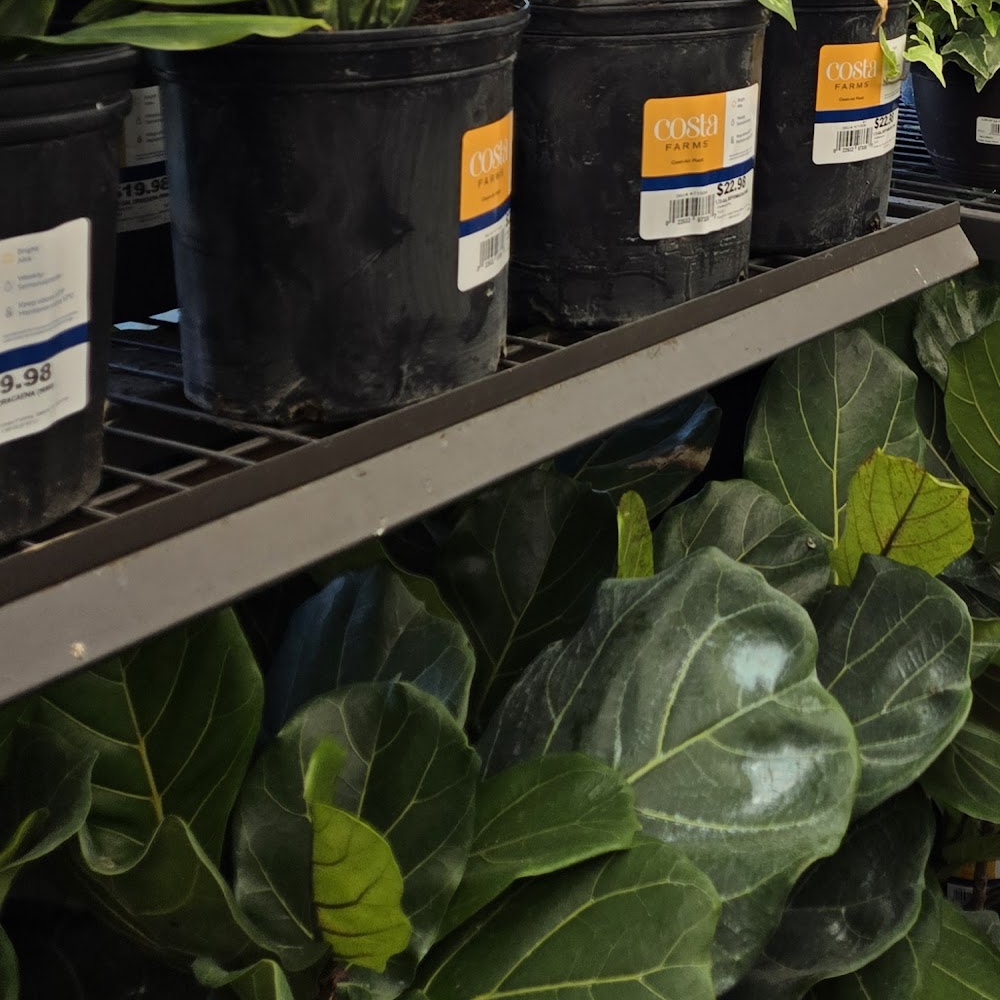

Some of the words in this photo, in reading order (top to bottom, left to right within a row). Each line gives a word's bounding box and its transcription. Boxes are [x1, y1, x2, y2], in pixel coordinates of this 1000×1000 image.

[826, 59, 877, 81] costa
[834, 82, 870, 90] FARMS
[653, 113, 718, 141] costa
[665, 140, 709, 151] FARMS
[716, 175, 747, 197] $22.98
[0, 362, 52, 394] 9.98
